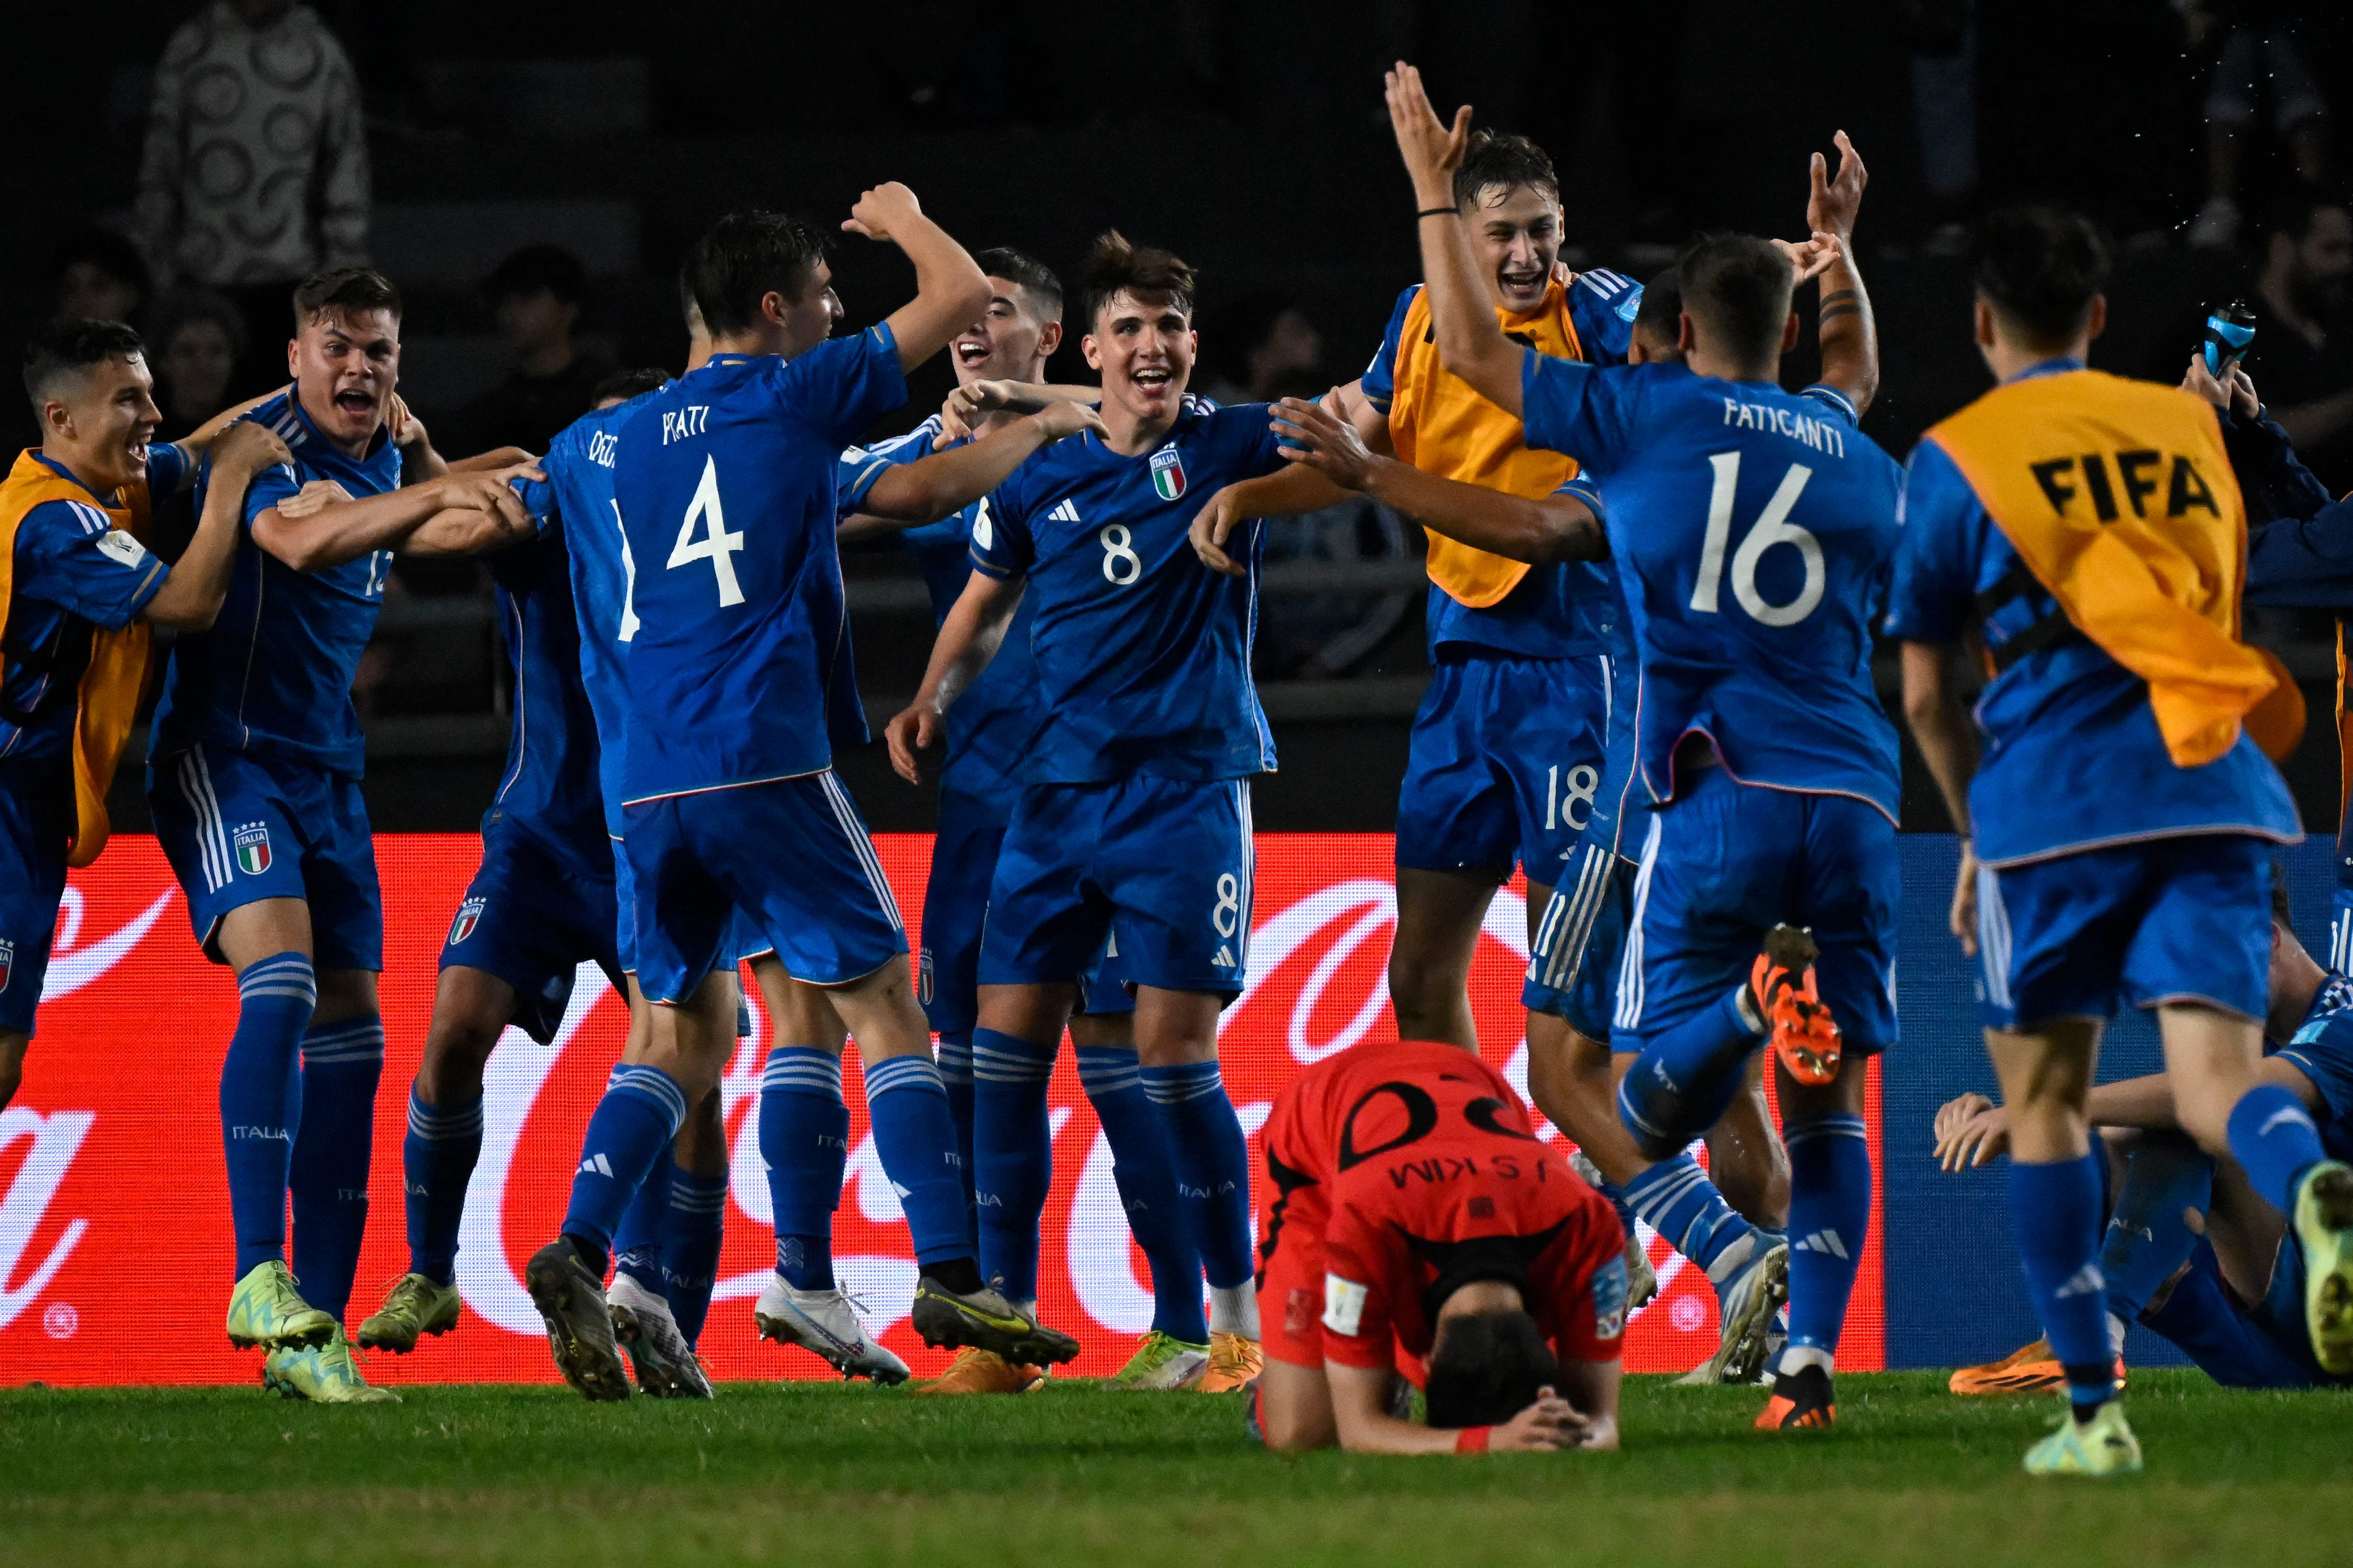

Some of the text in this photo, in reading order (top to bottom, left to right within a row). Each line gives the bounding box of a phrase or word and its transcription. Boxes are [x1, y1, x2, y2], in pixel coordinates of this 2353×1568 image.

[589, 430, 618, 468] DEG
[663, 406, 709, 445] PRATI
[1724, 397, 1844, 458] FATICANTI
[1152, 454, 1176, 469] ITALIA
[2030, 449, 2221, 524] FIFA
[667, 453, 745, 607] 4
[1100, 524, 1141, 585] 8
[1690, 451, 1826, 627] 16
[1546, 765, 1598, 830] 18
[237, 832, 266, 846] ITALIA
[1213, 873, 1237, 938] 8
[233, 1126, 289, 1141] ITALIA
[1388, 1157, 1477, 1189] KIM
[1491, 1155, 1519, 1179] S
